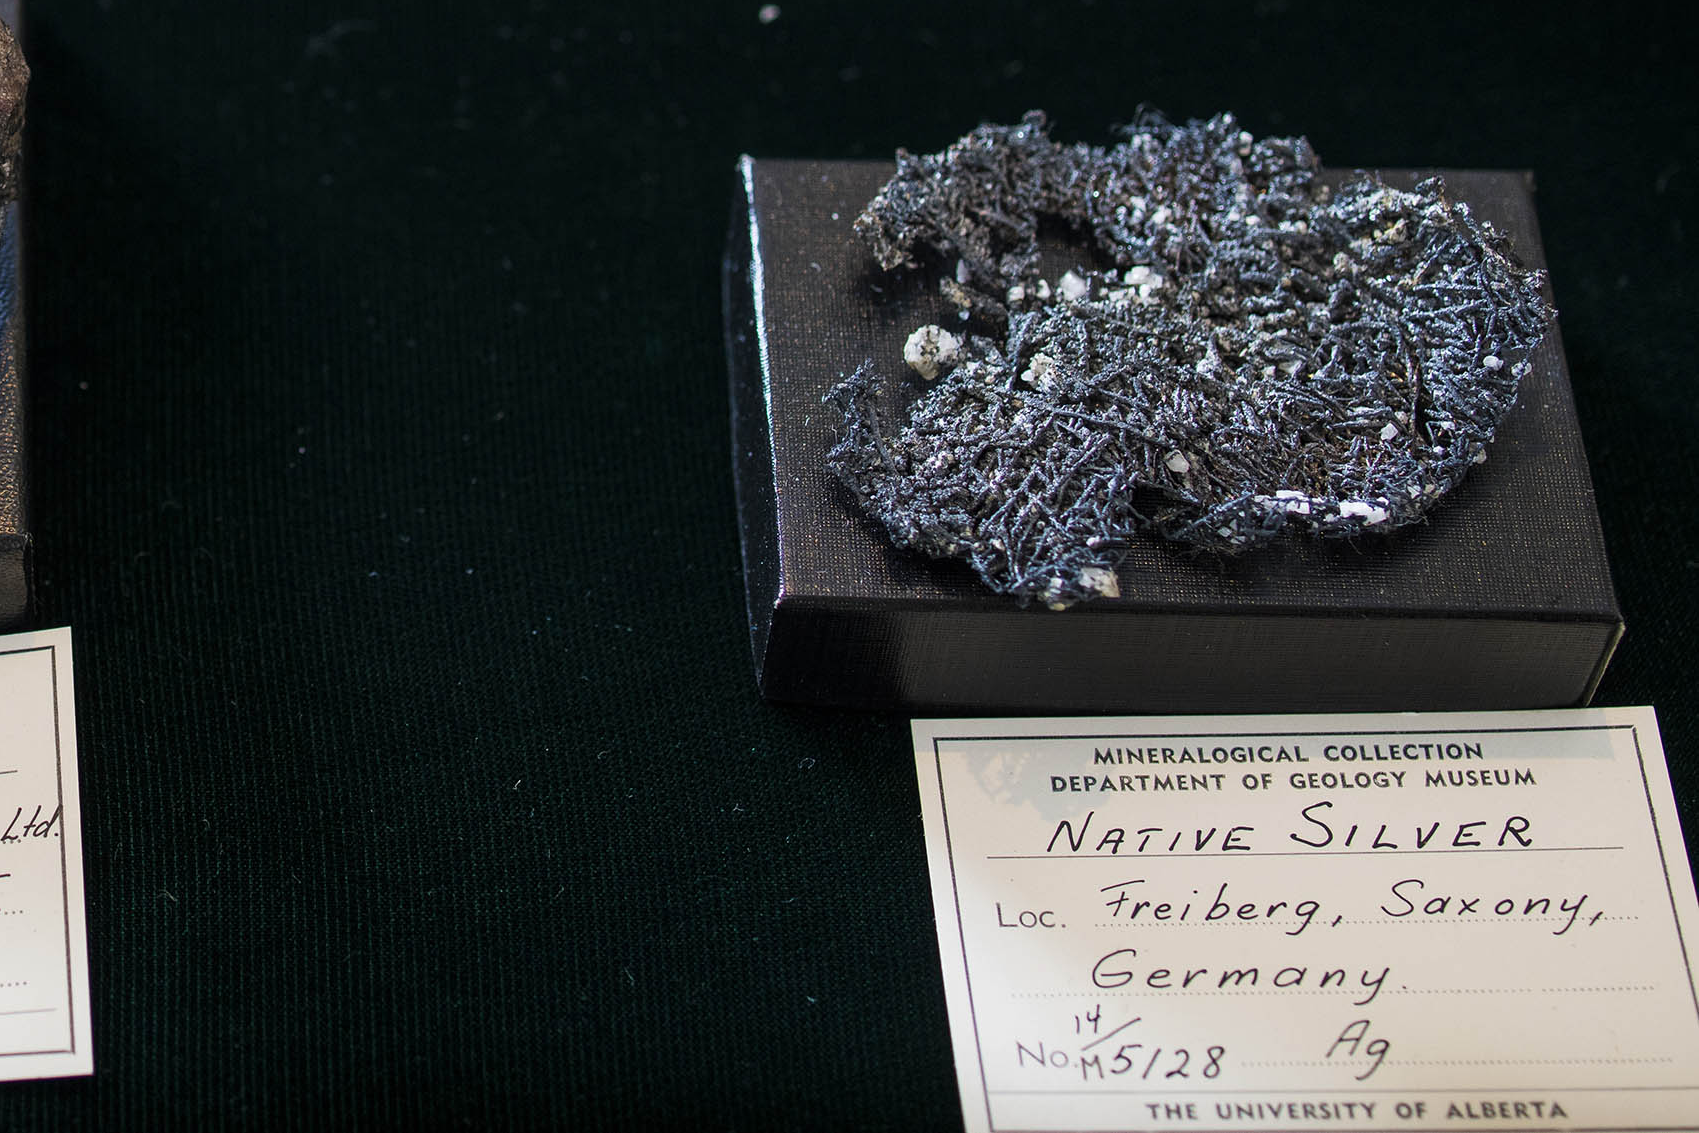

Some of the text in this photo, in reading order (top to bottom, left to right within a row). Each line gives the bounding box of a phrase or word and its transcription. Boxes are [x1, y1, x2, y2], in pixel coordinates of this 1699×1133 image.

[1093, 742, 1483, 766] MINERALOGICAL COLLECTION
[1051, 767, 1536, 793] DEPARTMENT OF GEOLOGY MUSEUM
[1, 804, 63, 843] Ltd.
[1046, 800, 1534, 854] NATIVE SILVER
[998, 880, 1604, 935] Loc. Freiberg, Saxony,
[1326, 1020, 1391, 1080] Ag
[1145, 1099, 1569, 1121] THE UNIVERSITY OF ALBERTA
